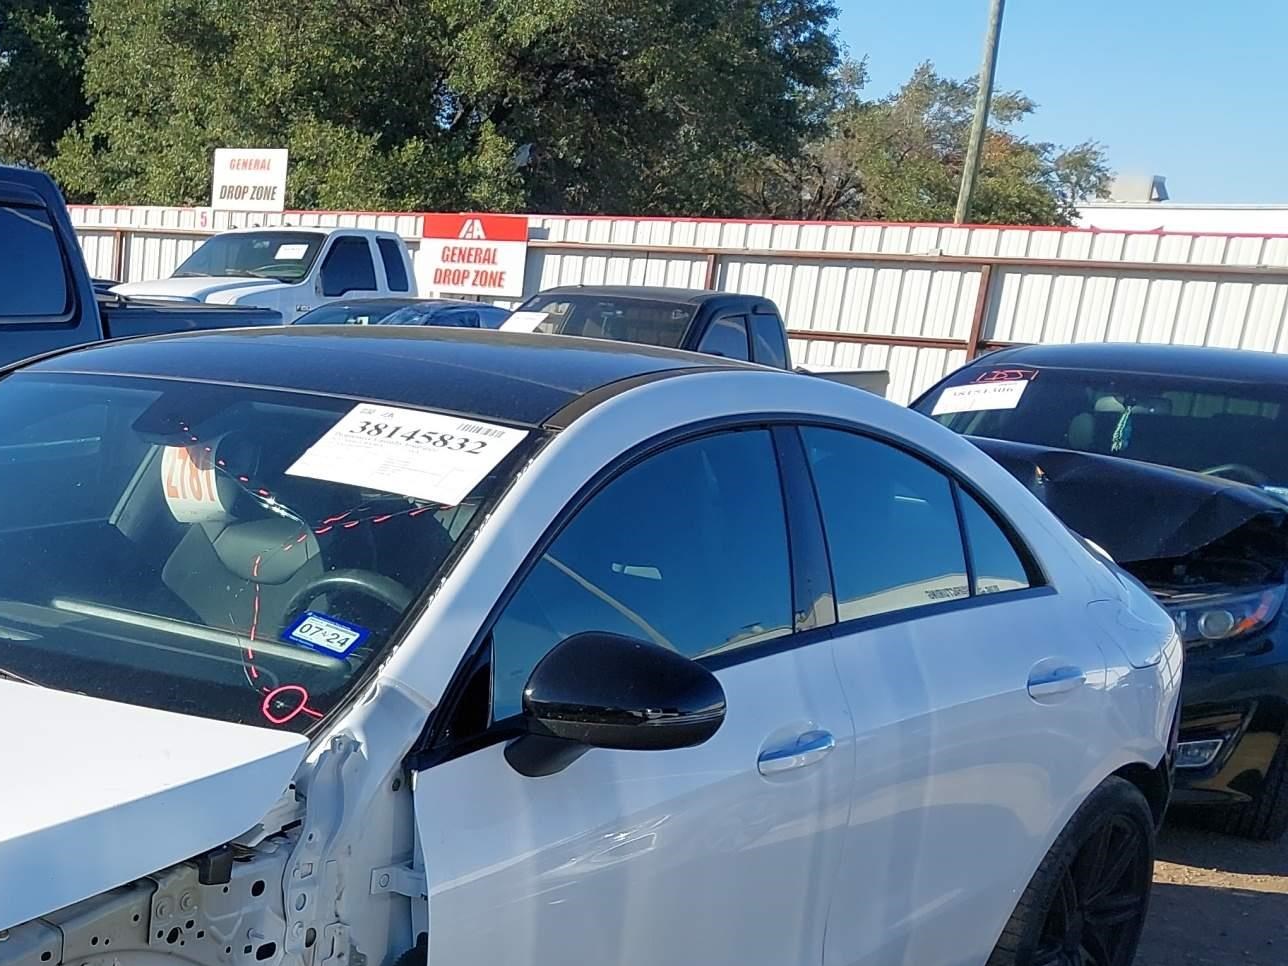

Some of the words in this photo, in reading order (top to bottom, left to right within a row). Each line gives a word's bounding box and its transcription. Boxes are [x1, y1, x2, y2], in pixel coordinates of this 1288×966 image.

[229, 158, 272, 171] GENERAL
[219, 185, 249, 201] DROP
[249, 186, 278, 201] ZONE
[200, 211, 208, 228] 5
[441, 246, 499, 265] GENERAL
[433, 268, 470, 287] DROP
[471, 270, 507, 288] ZONE
[349, 420, 489, 455] 38145832
